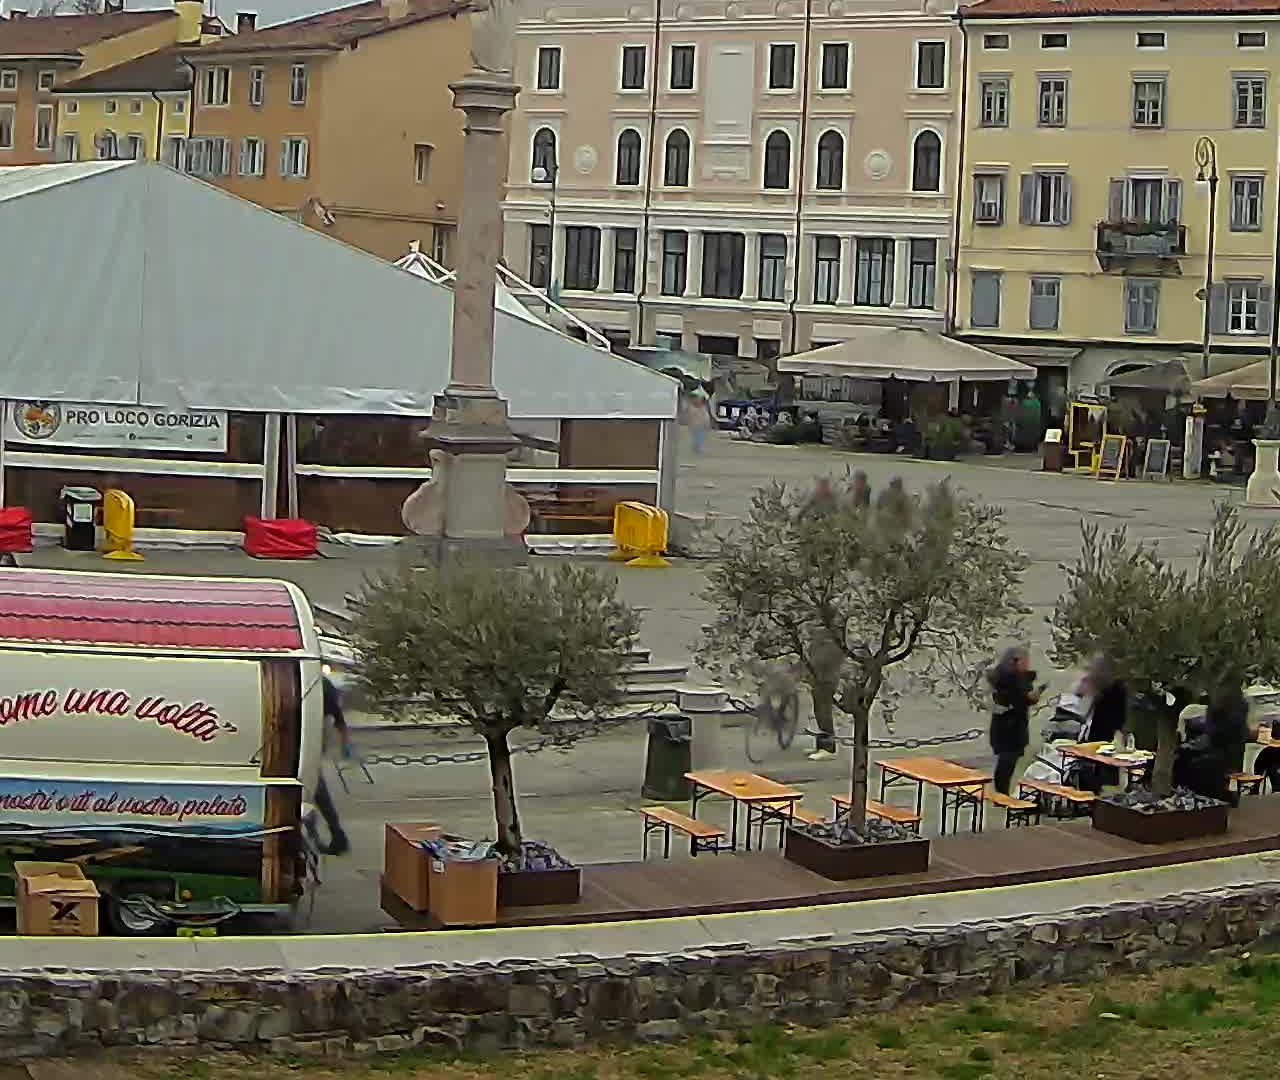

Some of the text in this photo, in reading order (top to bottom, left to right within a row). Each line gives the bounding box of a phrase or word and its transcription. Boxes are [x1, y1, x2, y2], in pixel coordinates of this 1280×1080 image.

[66, 410, 220, 428] PRO LOCO GORIZIA
[63, 688, 130, 716] una
[91, 791, 119, 813] al
[117, 793, 178, 816] vostro
[176, 793, 248, 822] palato
